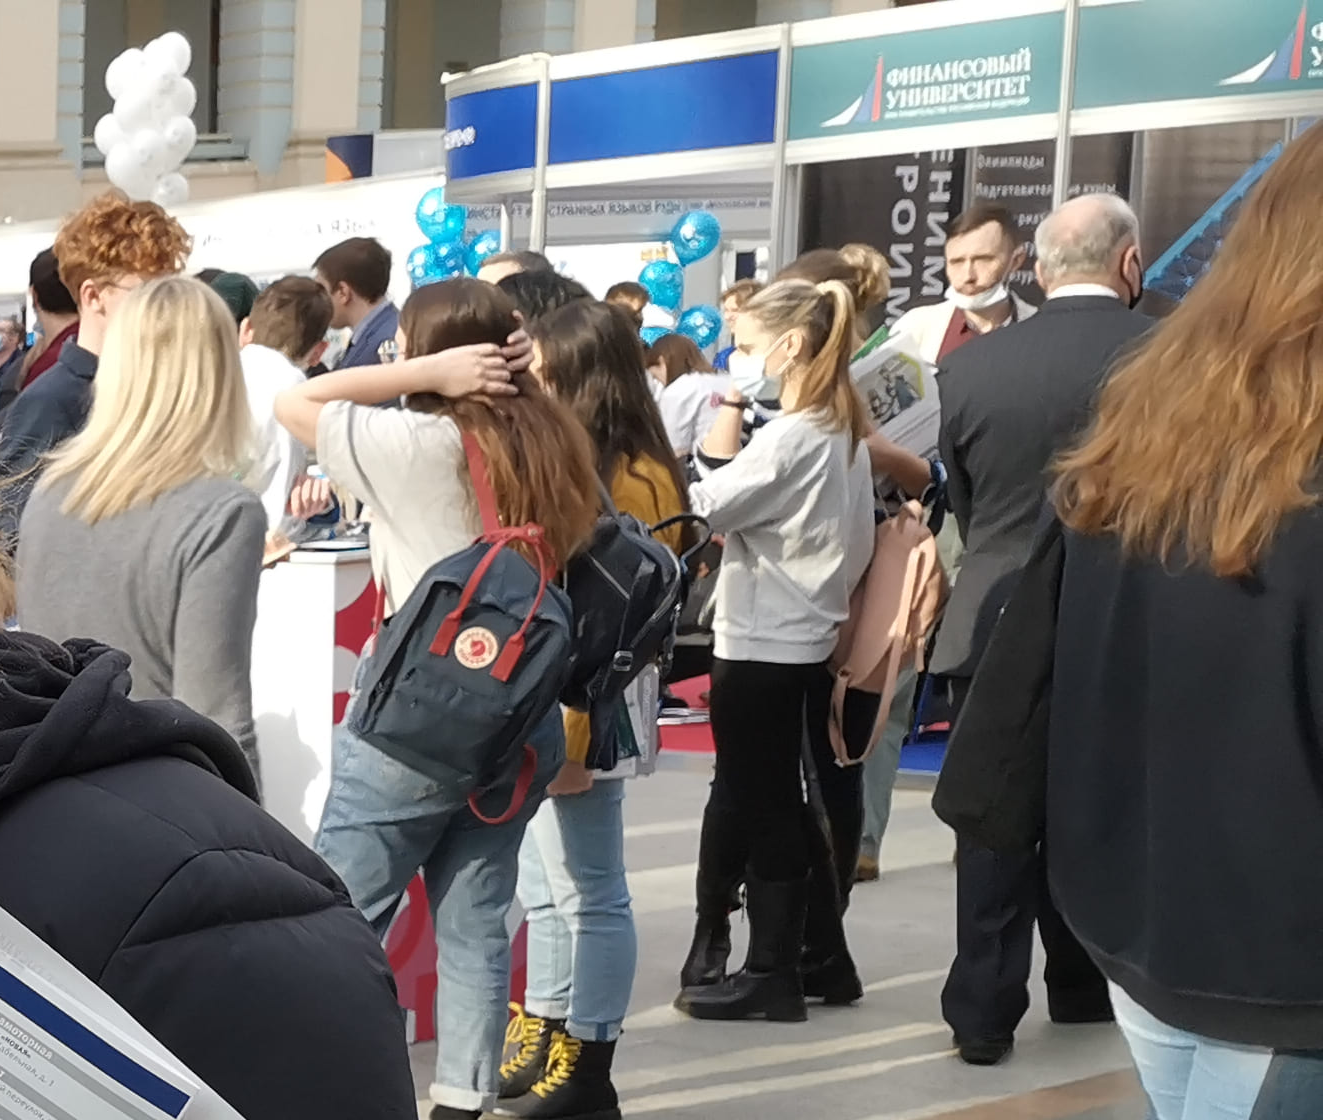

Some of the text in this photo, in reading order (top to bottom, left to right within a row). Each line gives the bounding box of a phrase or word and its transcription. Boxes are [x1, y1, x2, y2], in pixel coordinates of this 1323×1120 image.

[886, 46, 1032, 87] ФИНАНСОВЫЙ
[886, 75, 1031, 110] УНИВЕРСИТЕТ
[884, 152, 920, 327] РОИМ
